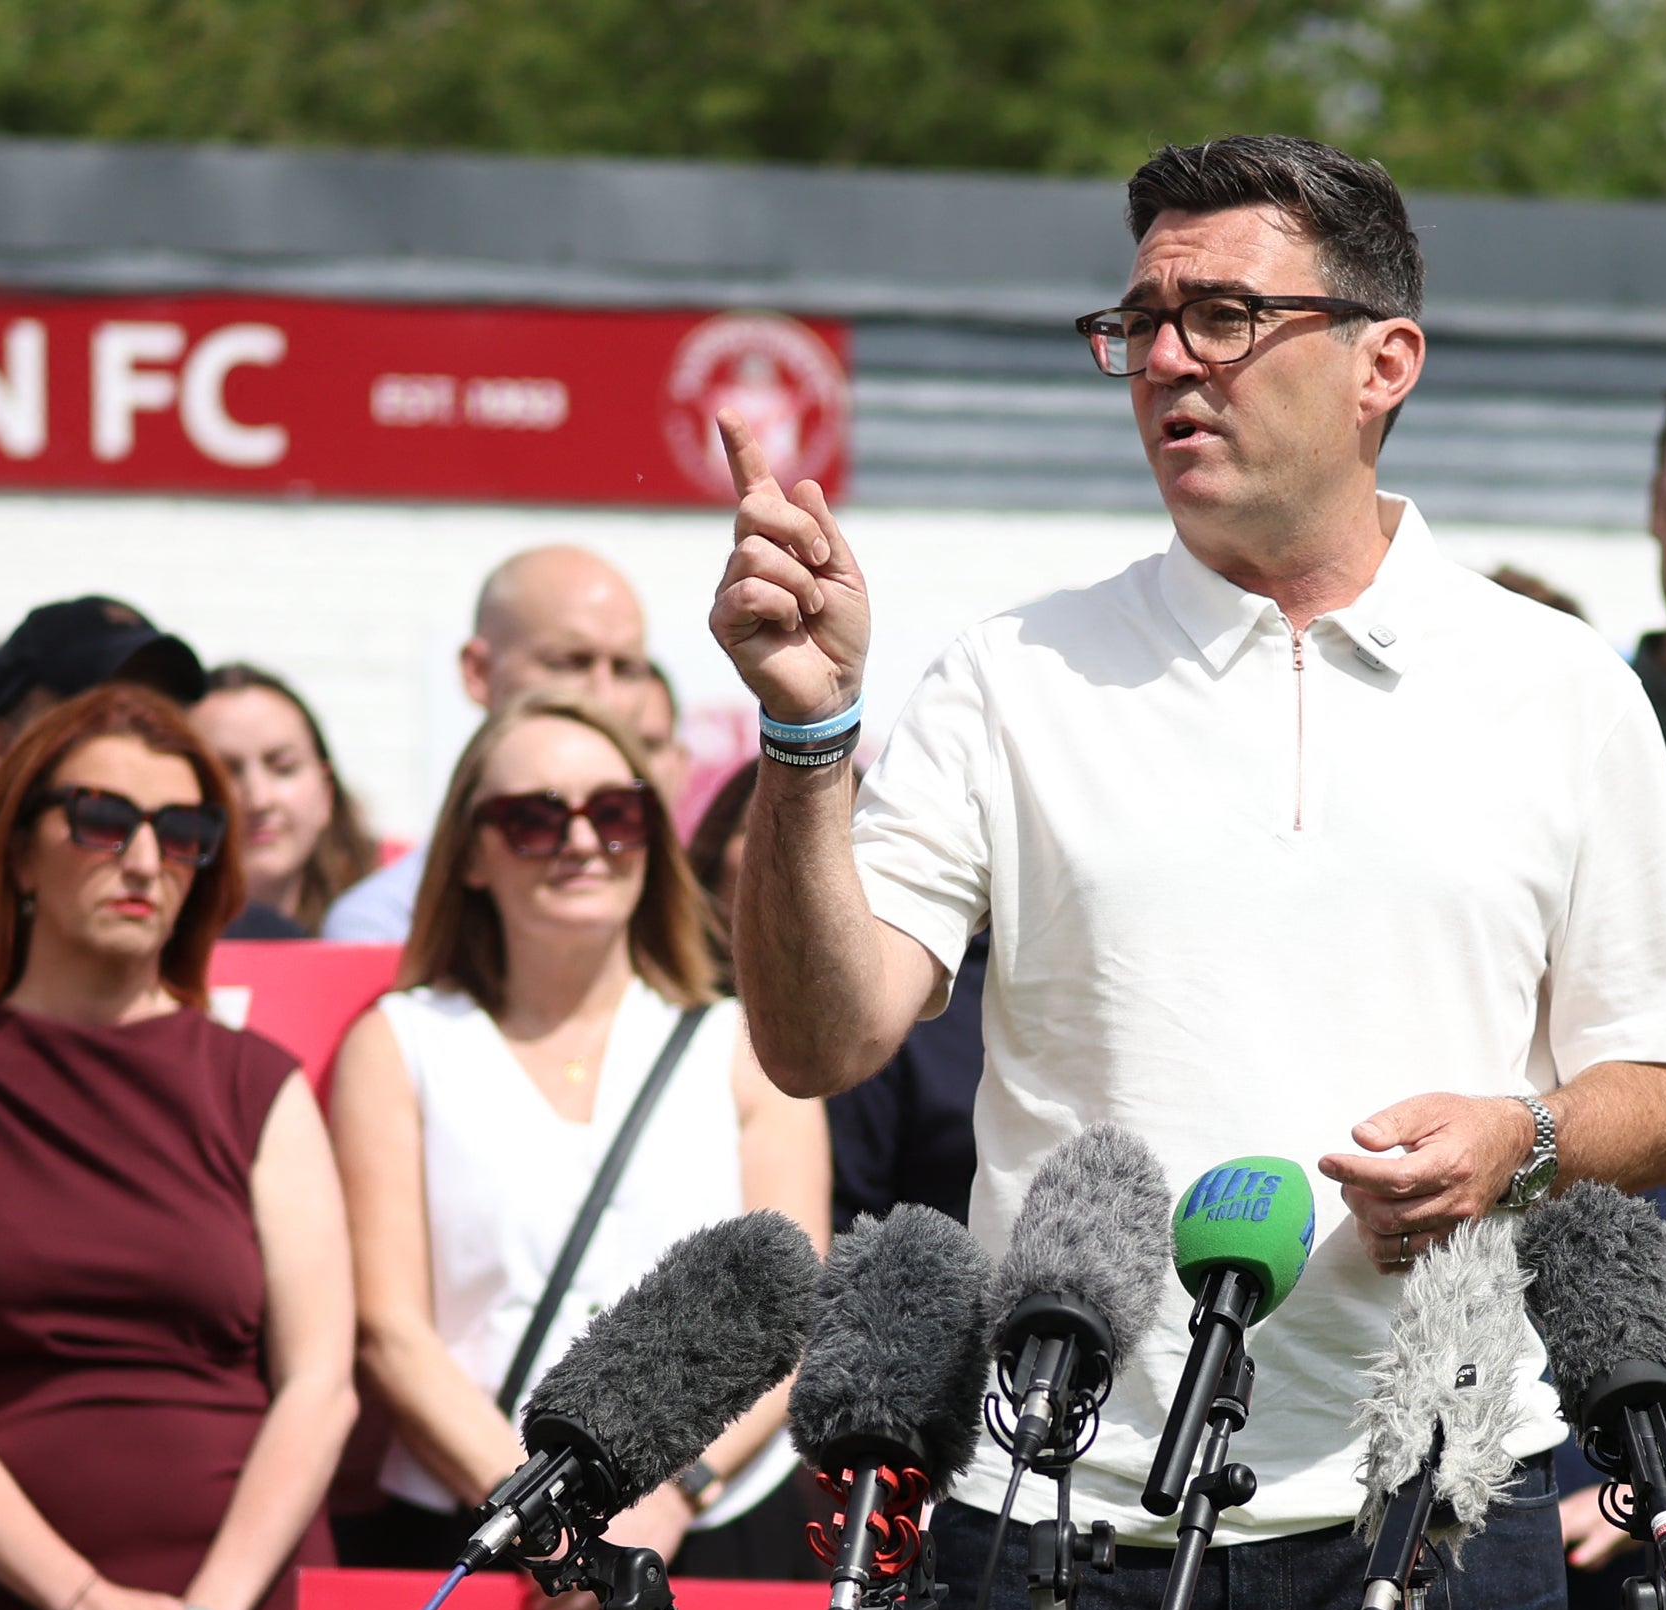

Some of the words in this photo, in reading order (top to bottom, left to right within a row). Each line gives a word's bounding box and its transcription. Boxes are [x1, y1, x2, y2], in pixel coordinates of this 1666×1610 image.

[91, 318, 290, 468] FC
[766, 744, 844, 766] #ANDYSMANCLUB
[1182, 1166, 1282, 1222] HITS
[1205, 1197, 1272, 1223] RADIO
